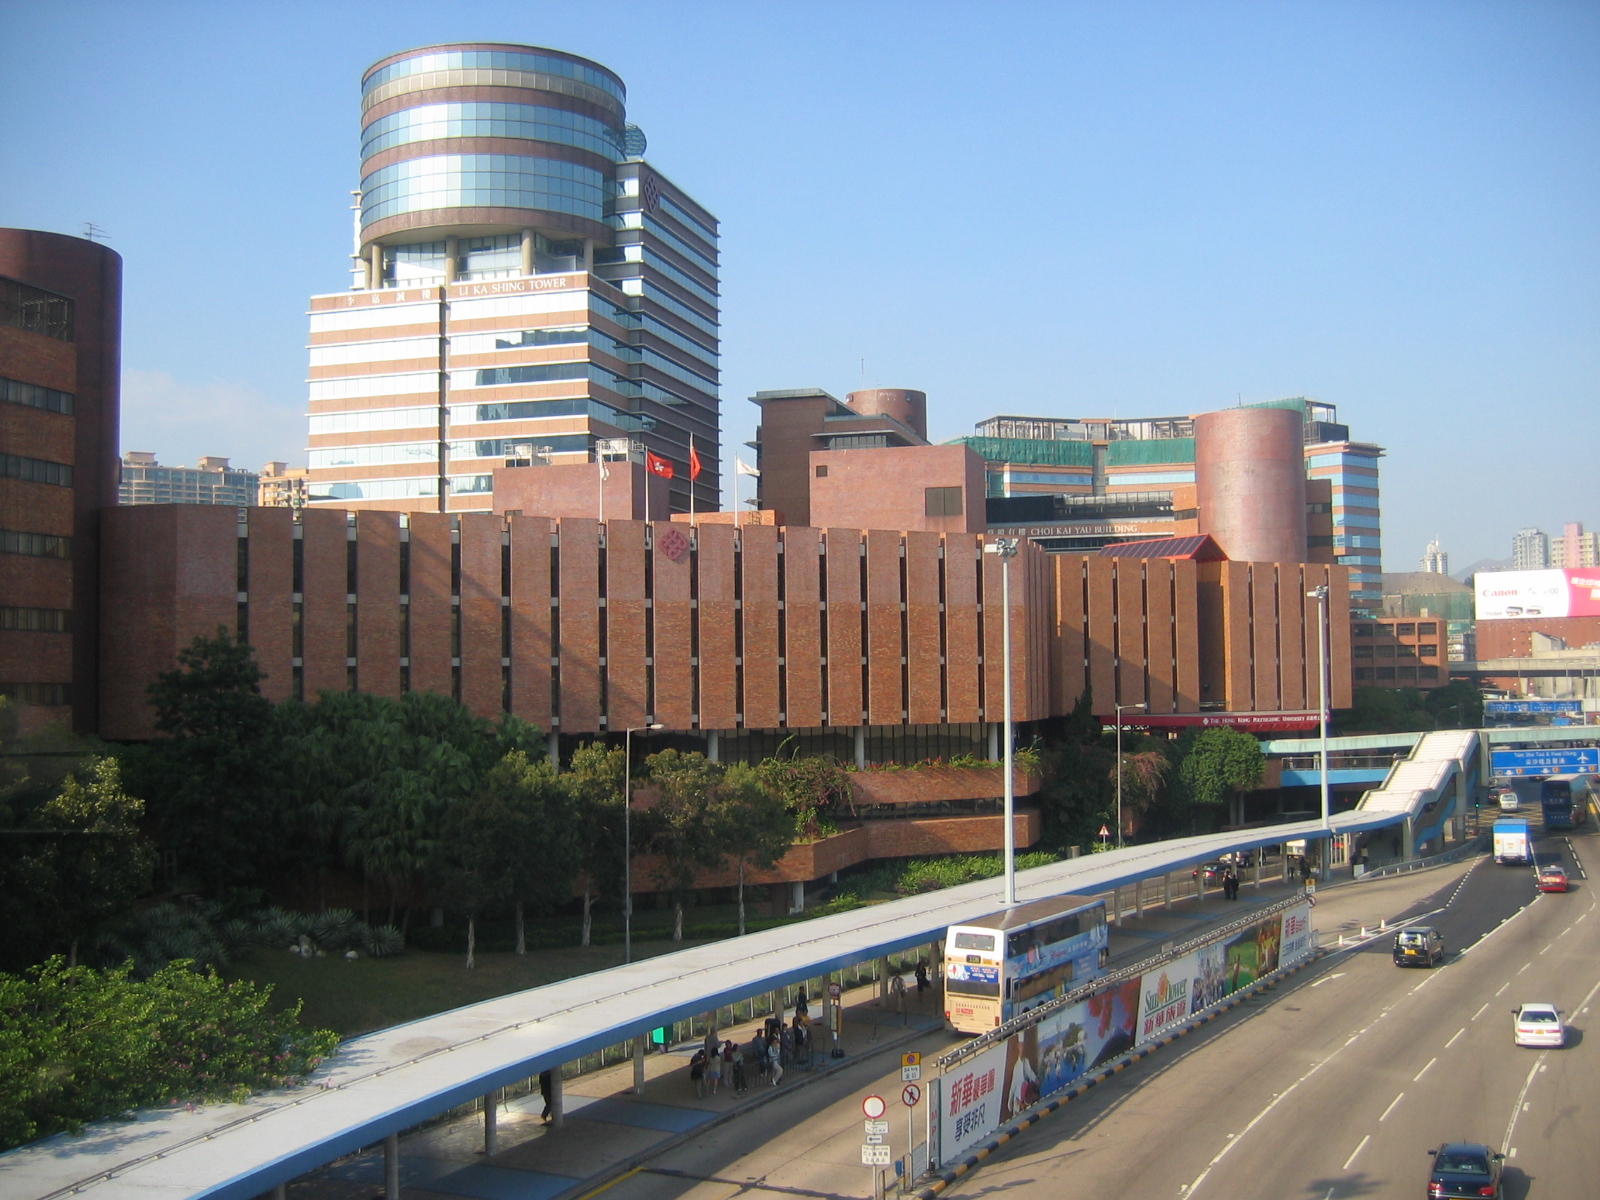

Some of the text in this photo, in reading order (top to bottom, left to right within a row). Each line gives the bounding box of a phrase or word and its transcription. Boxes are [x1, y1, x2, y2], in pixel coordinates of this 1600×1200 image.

[459, 277, 567, 296] LI KA SHING TOWER
[1031, 524, 1138, 536] CHOI KAI YAU BUILDING
[1482, 589, 1518, 597] Canon
[955, 1103, 985, 1141] 享受非凡
